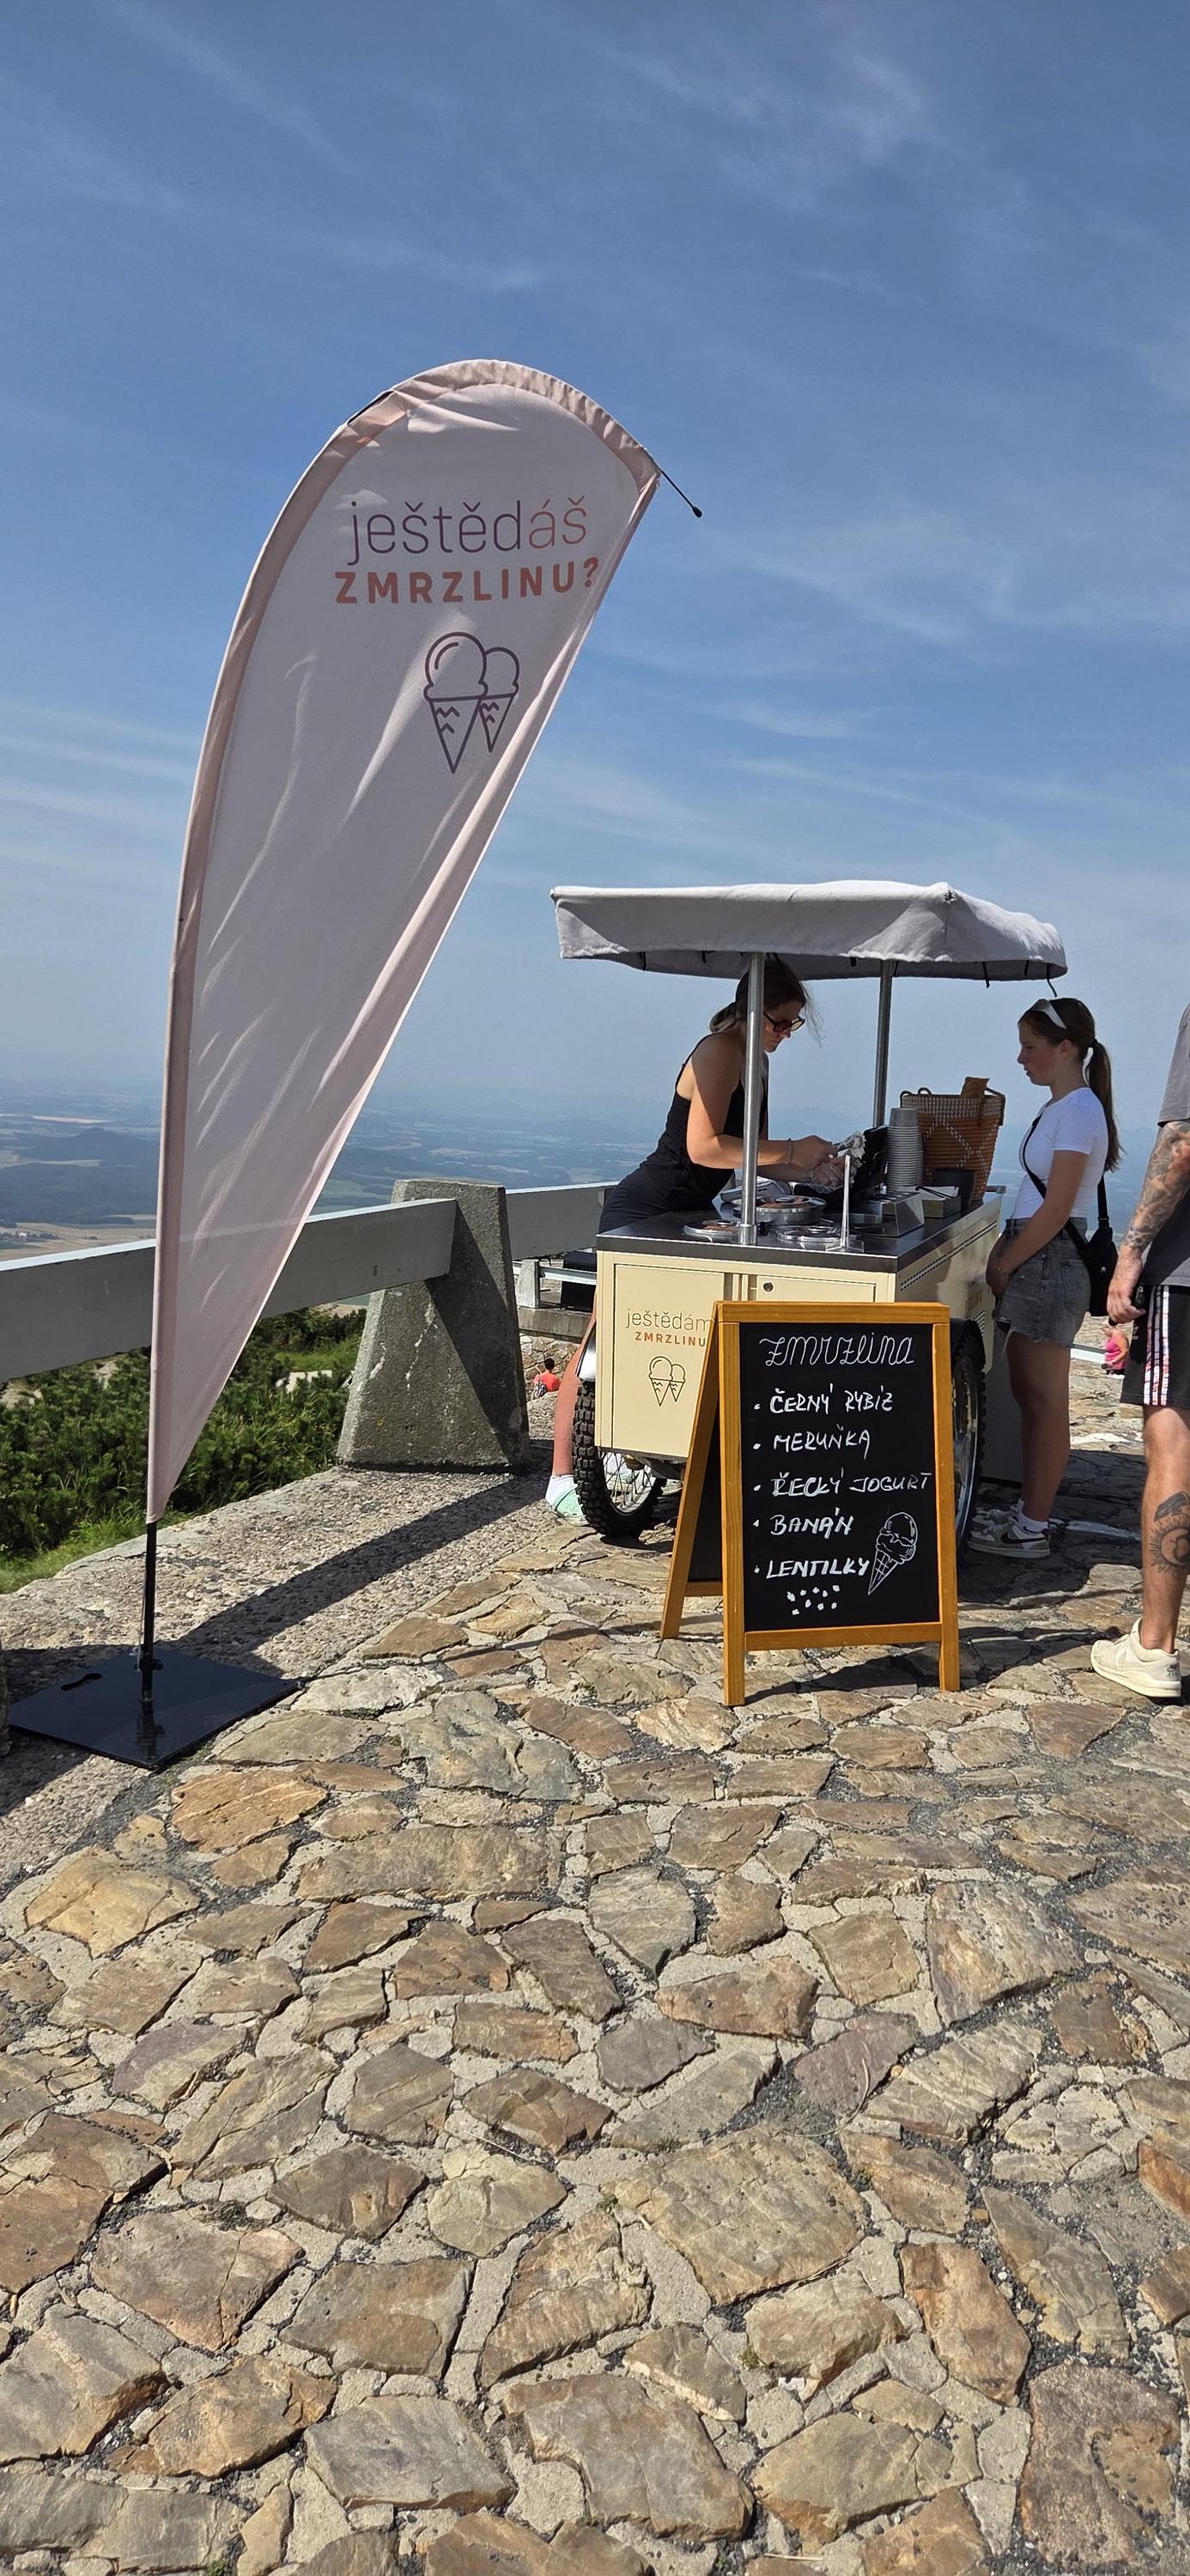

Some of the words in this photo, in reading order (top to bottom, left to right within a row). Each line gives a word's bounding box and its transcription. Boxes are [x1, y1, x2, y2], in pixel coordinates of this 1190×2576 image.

[347, 495, 587, 567] ještědáš
[334, 556, 599, 605] ZMRZLINU?
[625, 1308, 711, 1332] ještědám
[635, 1331, 706, 1347] ZMRZLINU
[769, 1382, 833, 1414] ČERNÝ
[844, 1385, 893, 1413] RYBÍZ
[774, 1424, 871, 1460] MERUŇKA
[770, 1467, 845, 1497] ŘECKÝ
[848, 1472, 933, 1493] JOGURT
[769, 1506, 854, 1540] BANÁN
[766, 1557, 870, 1579] LENTILKY
